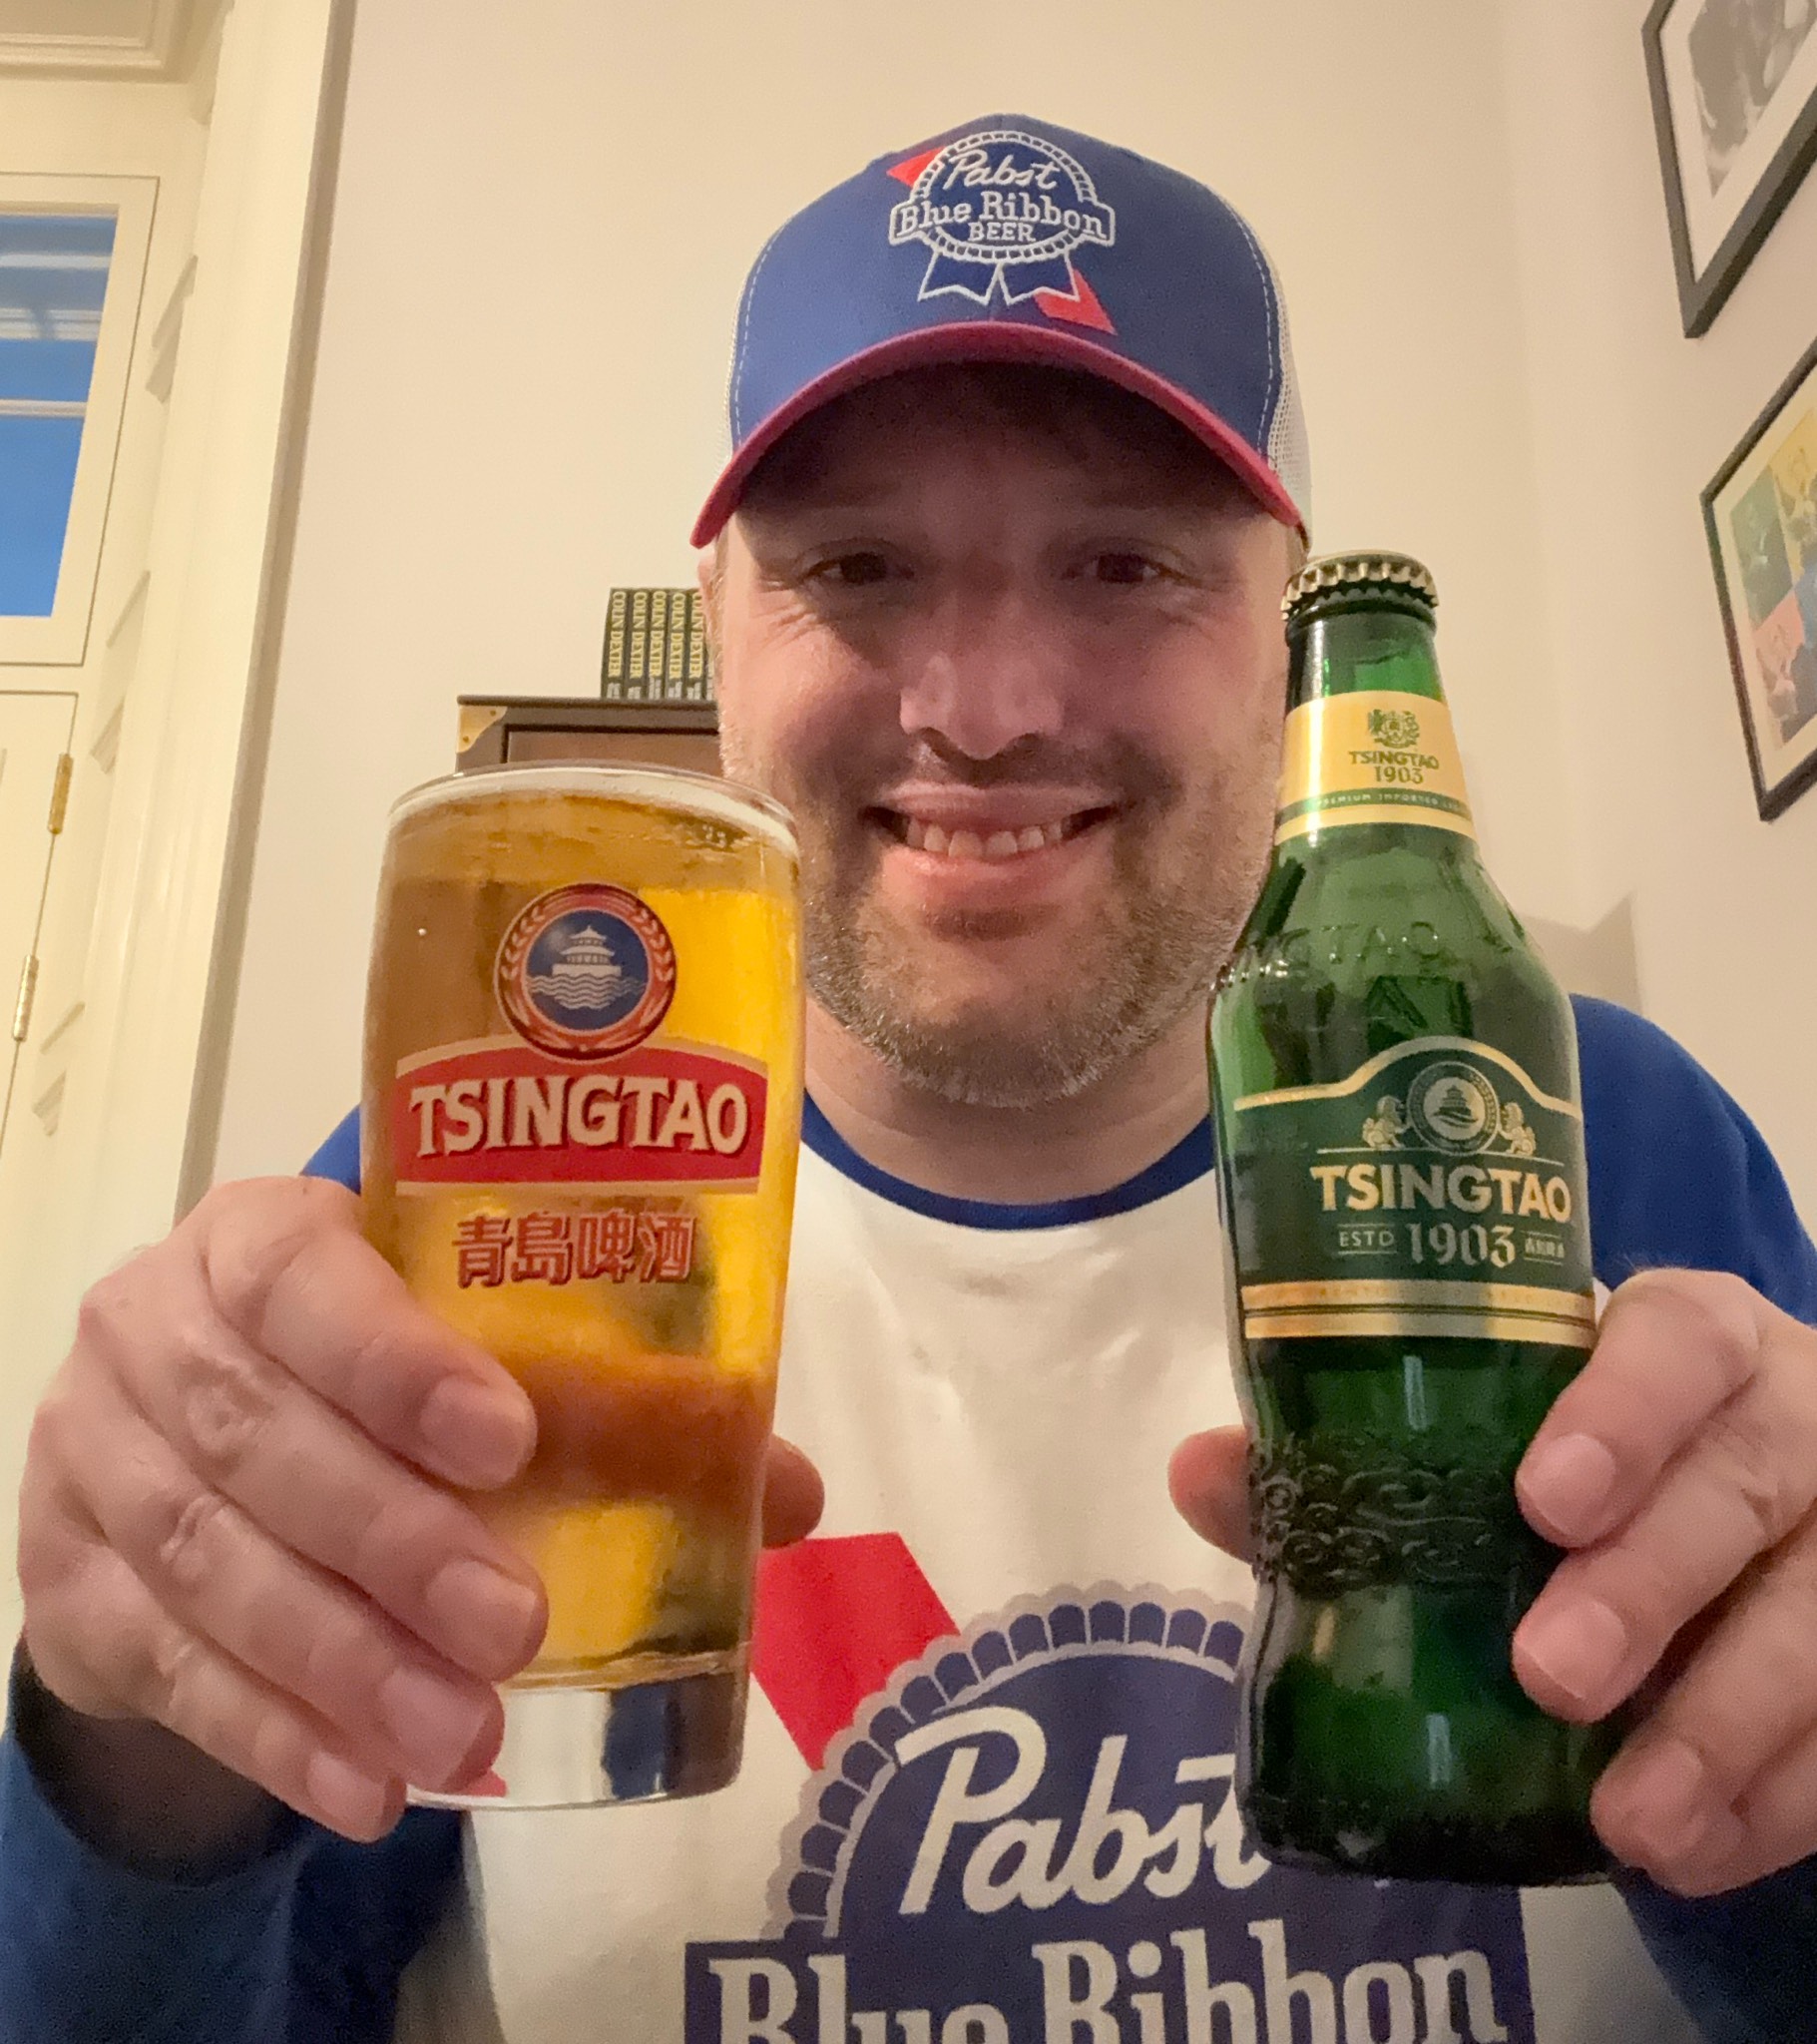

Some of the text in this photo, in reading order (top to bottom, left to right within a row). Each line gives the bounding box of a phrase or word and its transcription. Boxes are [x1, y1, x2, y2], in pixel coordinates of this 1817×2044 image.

[942, 149, 1061, 191] Pabst
[896, 190, 1107, 240] Blue Ribbon
[968, 222, 1037, 243] BEER
[612, 591, 627, 629] COLIN
[633, 591, 648, 629] COLIN
[652, 590, 668, 629] COLIN
[672, 592, 686, 630] COLIN
[608, 631, 624, 677] DEXTER
[630, 631, 646, 679] DEXTER
[649, 630, 665, 677] DEXTER
[669, 632, 684, 679] DEXTER
[688, 631, 703, 679] DEXTER
[1349, 751, 1440, 769] TSINGTAO
[1373, 766, 1424, 784] 1903
[409, 1073, 749, 1158] TSINGTAO
[1309, 1163, 1572, 1224] TSINGTAO
[452, 1210, 697, 1288] 青島啤酒
[1339, 1231, 1395, 1248] ESTD
[1405, 1222, 1516, 1269] 1903
[895, 1706, 1272, 1915] Pabst
[1032, 1919, 1508, 2044] Ribbon
